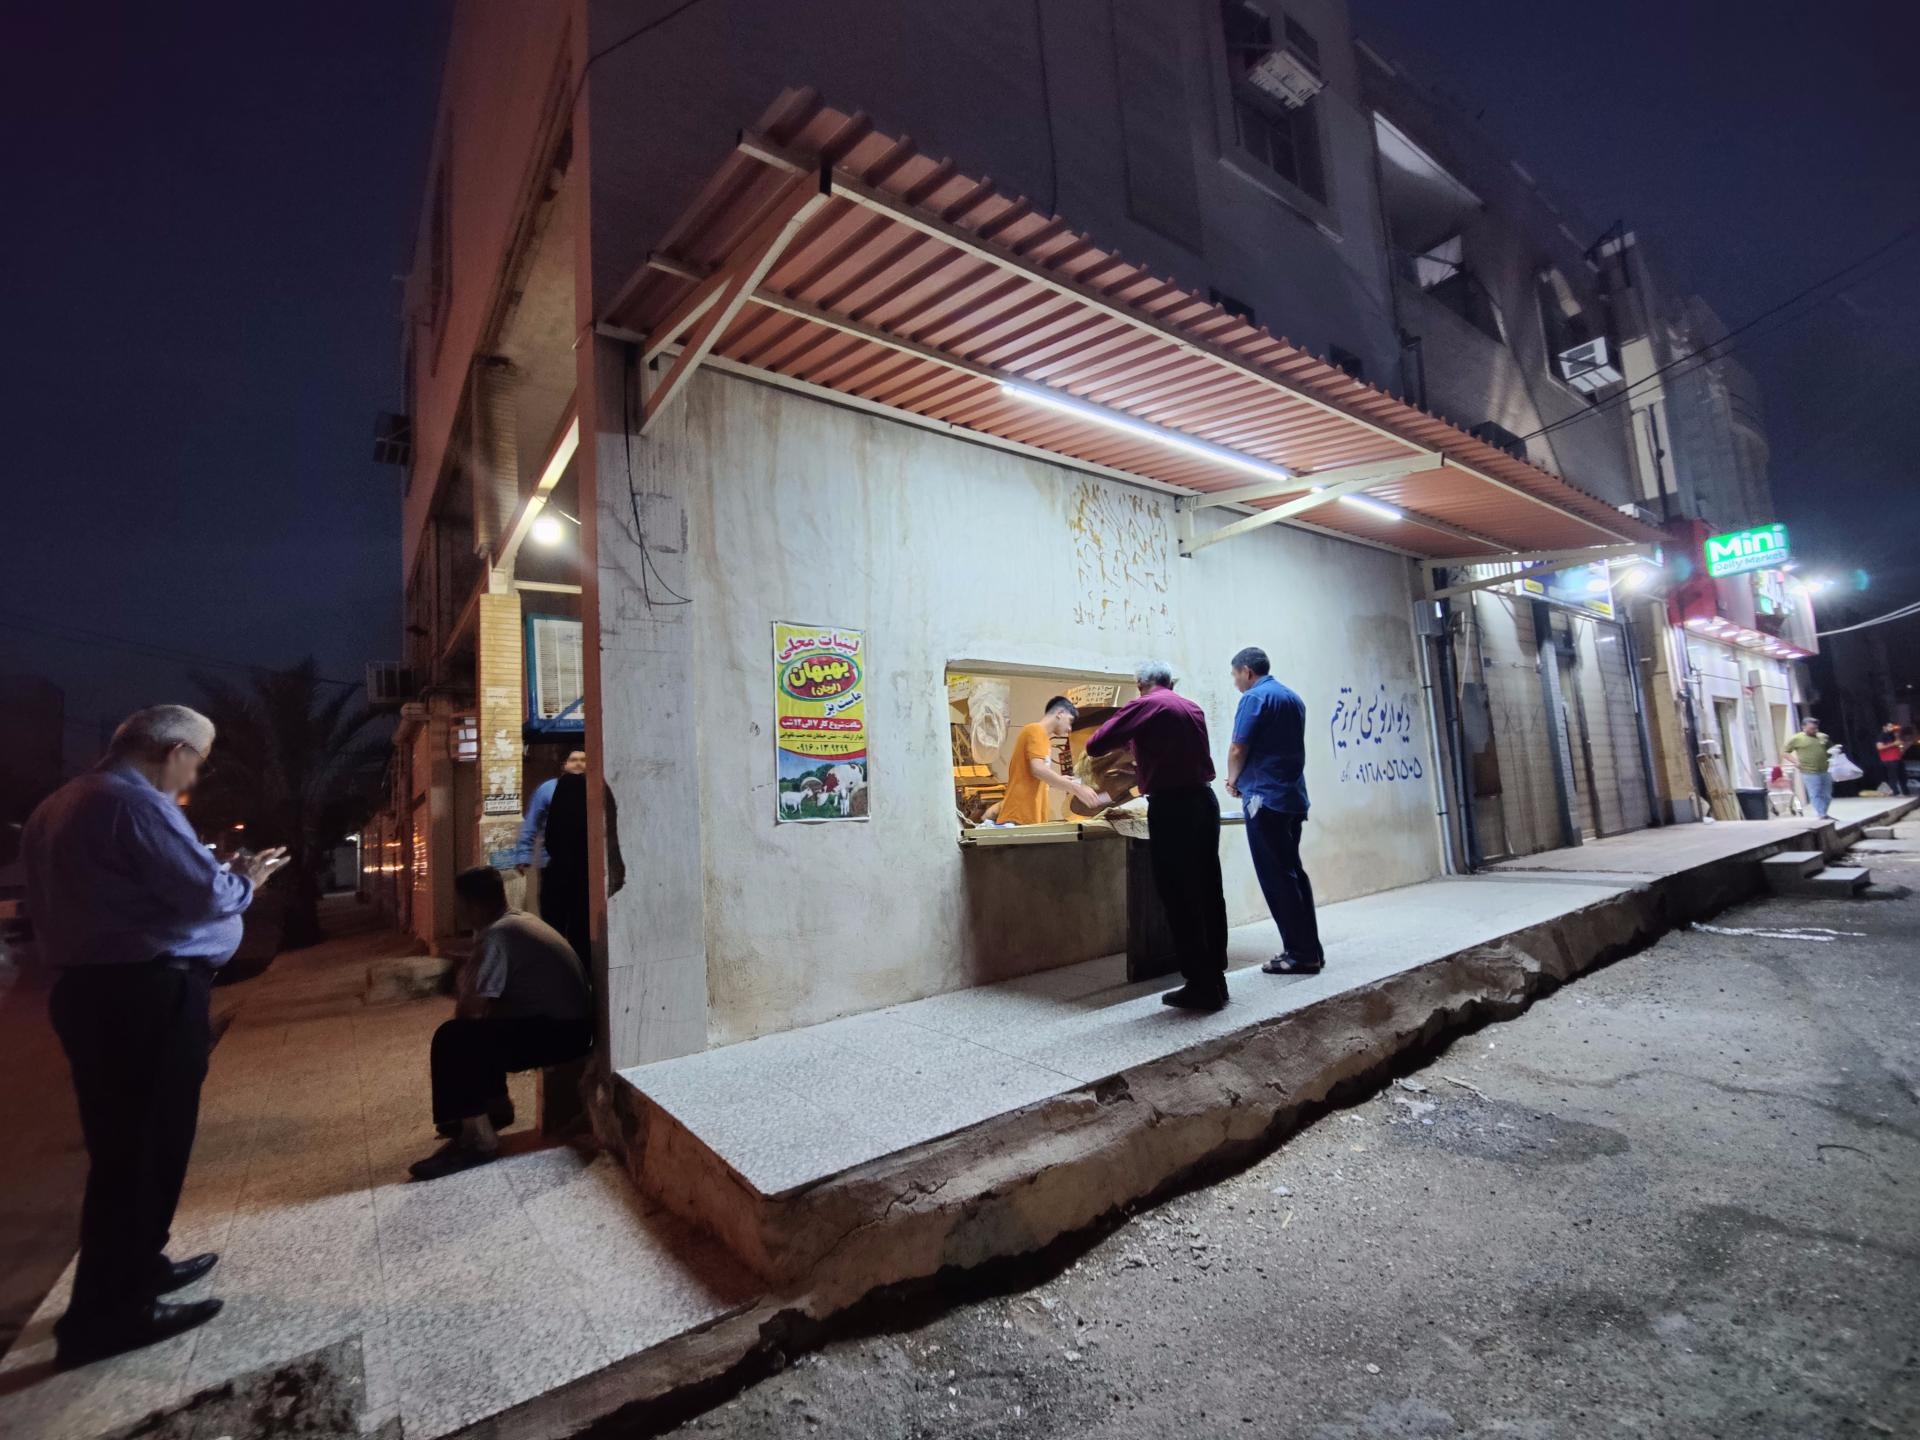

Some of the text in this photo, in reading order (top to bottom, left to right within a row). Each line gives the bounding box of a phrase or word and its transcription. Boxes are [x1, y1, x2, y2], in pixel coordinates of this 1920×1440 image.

[1709, 524, 1785, 562] Mini
[1715, 551, 1785, 571] Daily Market
[779, 634, 860, 660] لبنیات محلی
[789, 660, 850, 687] بهبهان
[837, 692, 862, 709] ماست
[829, 720, 846, 730] شروع
